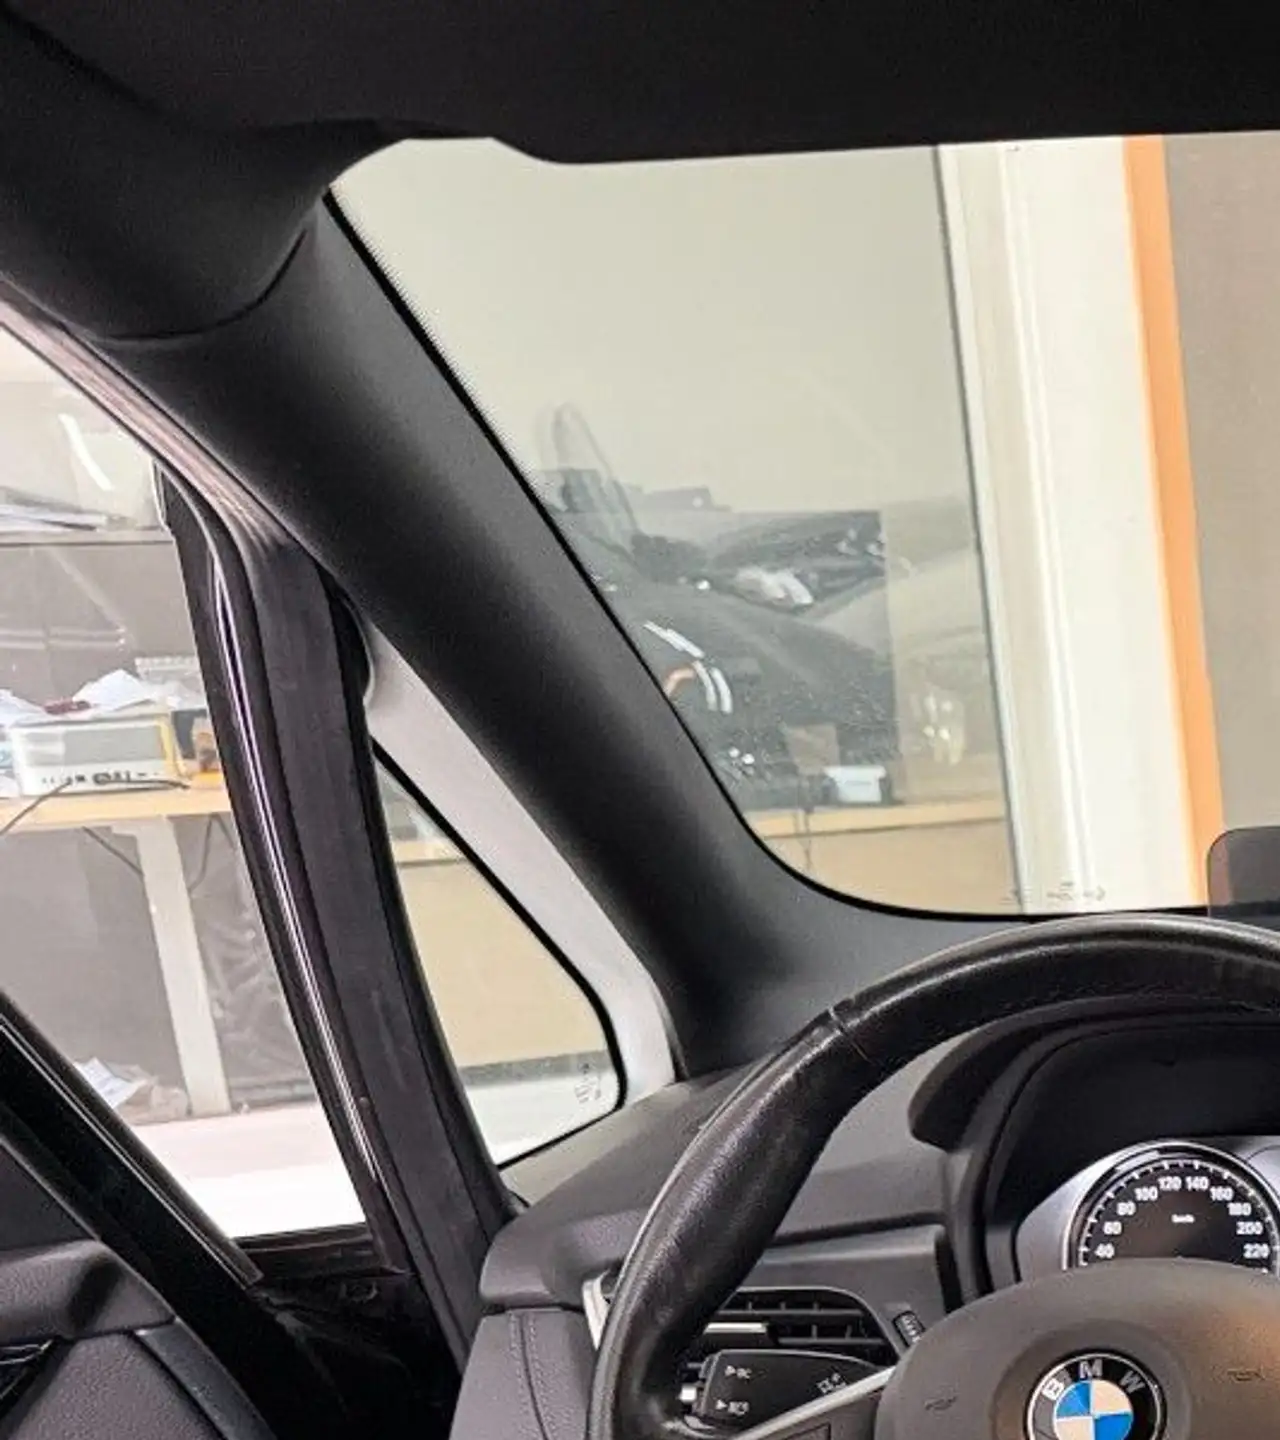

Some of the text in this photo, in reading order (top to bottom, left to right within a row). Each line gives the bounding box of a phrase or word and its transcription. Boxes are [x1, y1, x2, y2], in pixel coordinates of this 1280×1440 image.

[1158, 1176, 1182, 1191] 120
[1185, 1176, 1209, 1191] 140
[1134, 1186, 1159, 1201] 100
[1210, 1187, 1234, 1201] 160
[1117, 1202, 1136, 1216] 80
[1227, 1202, 1252, 1216] 180
[1236, 1221, 1263, 1235] 200
[1095, 1244, 1115, 1259] 40
[1243, 1244, 1270, 1258] 220
[1041, 1359, 1145, 1401] BMW
